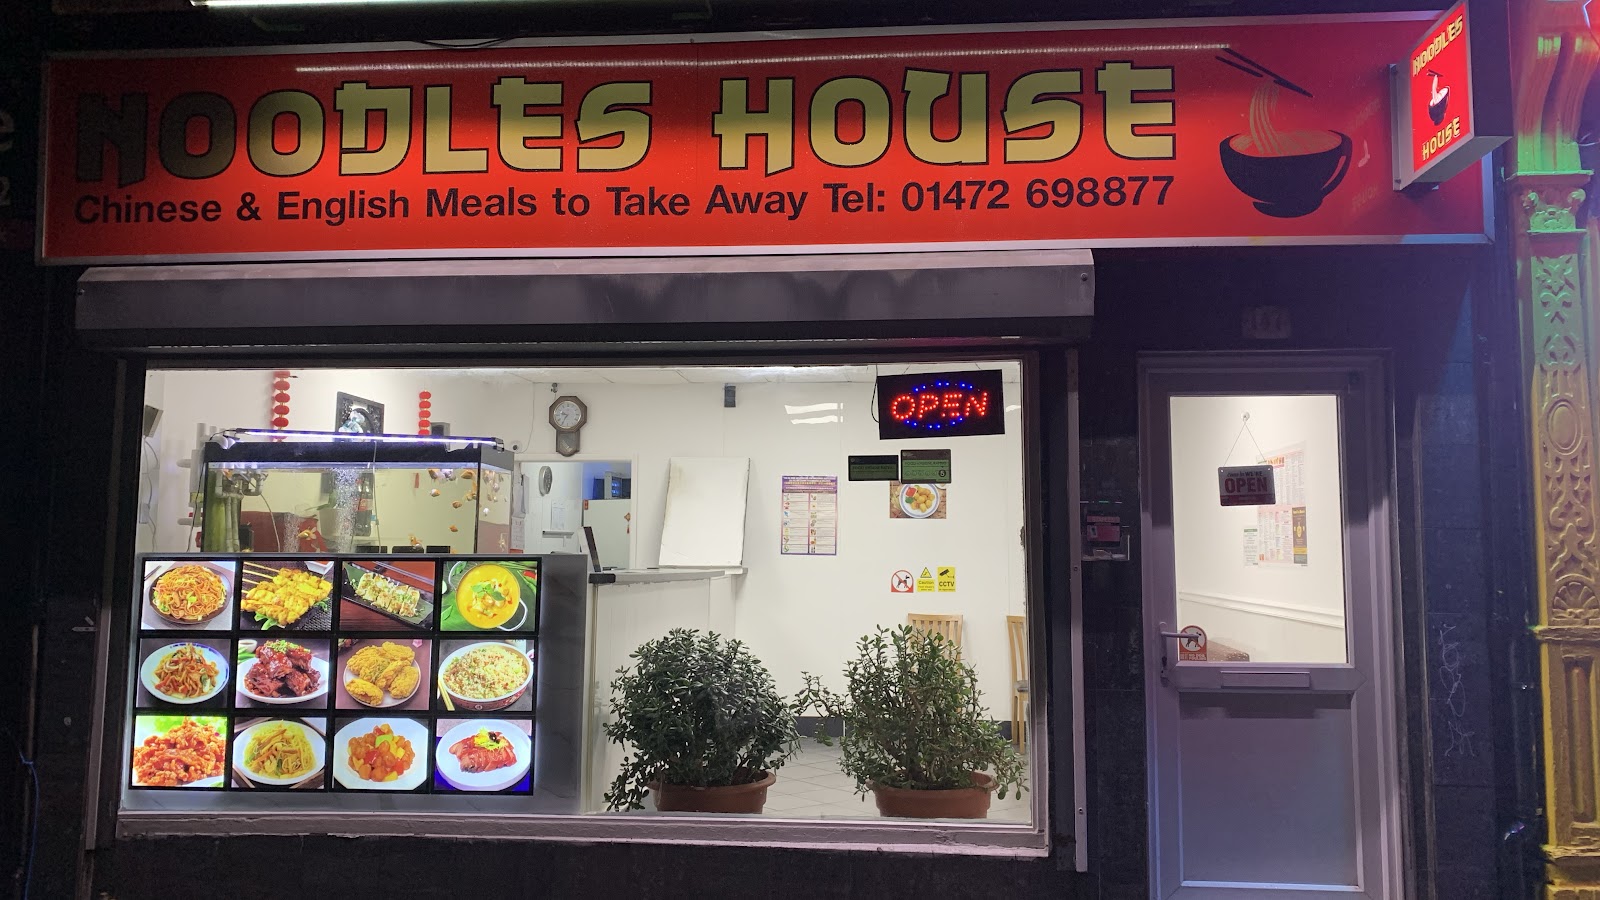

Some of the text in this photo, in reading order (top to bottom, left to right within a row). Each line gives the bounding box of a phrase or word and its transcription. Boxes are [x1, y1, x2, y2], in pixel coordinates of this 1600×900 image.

[1413, 15, 1463, 77] NOODLES
[75, 61, 1176, 188] NOODLES HOUSE
[1422, 117, 1461, 160] HOUSE
[74, 175, 1175, 226] Chinese & English Meals to Take Away Tel: 01472 698877
[891, 391, 988, 420] OPEN
[1224, 477, 1268, 494] OPEN
